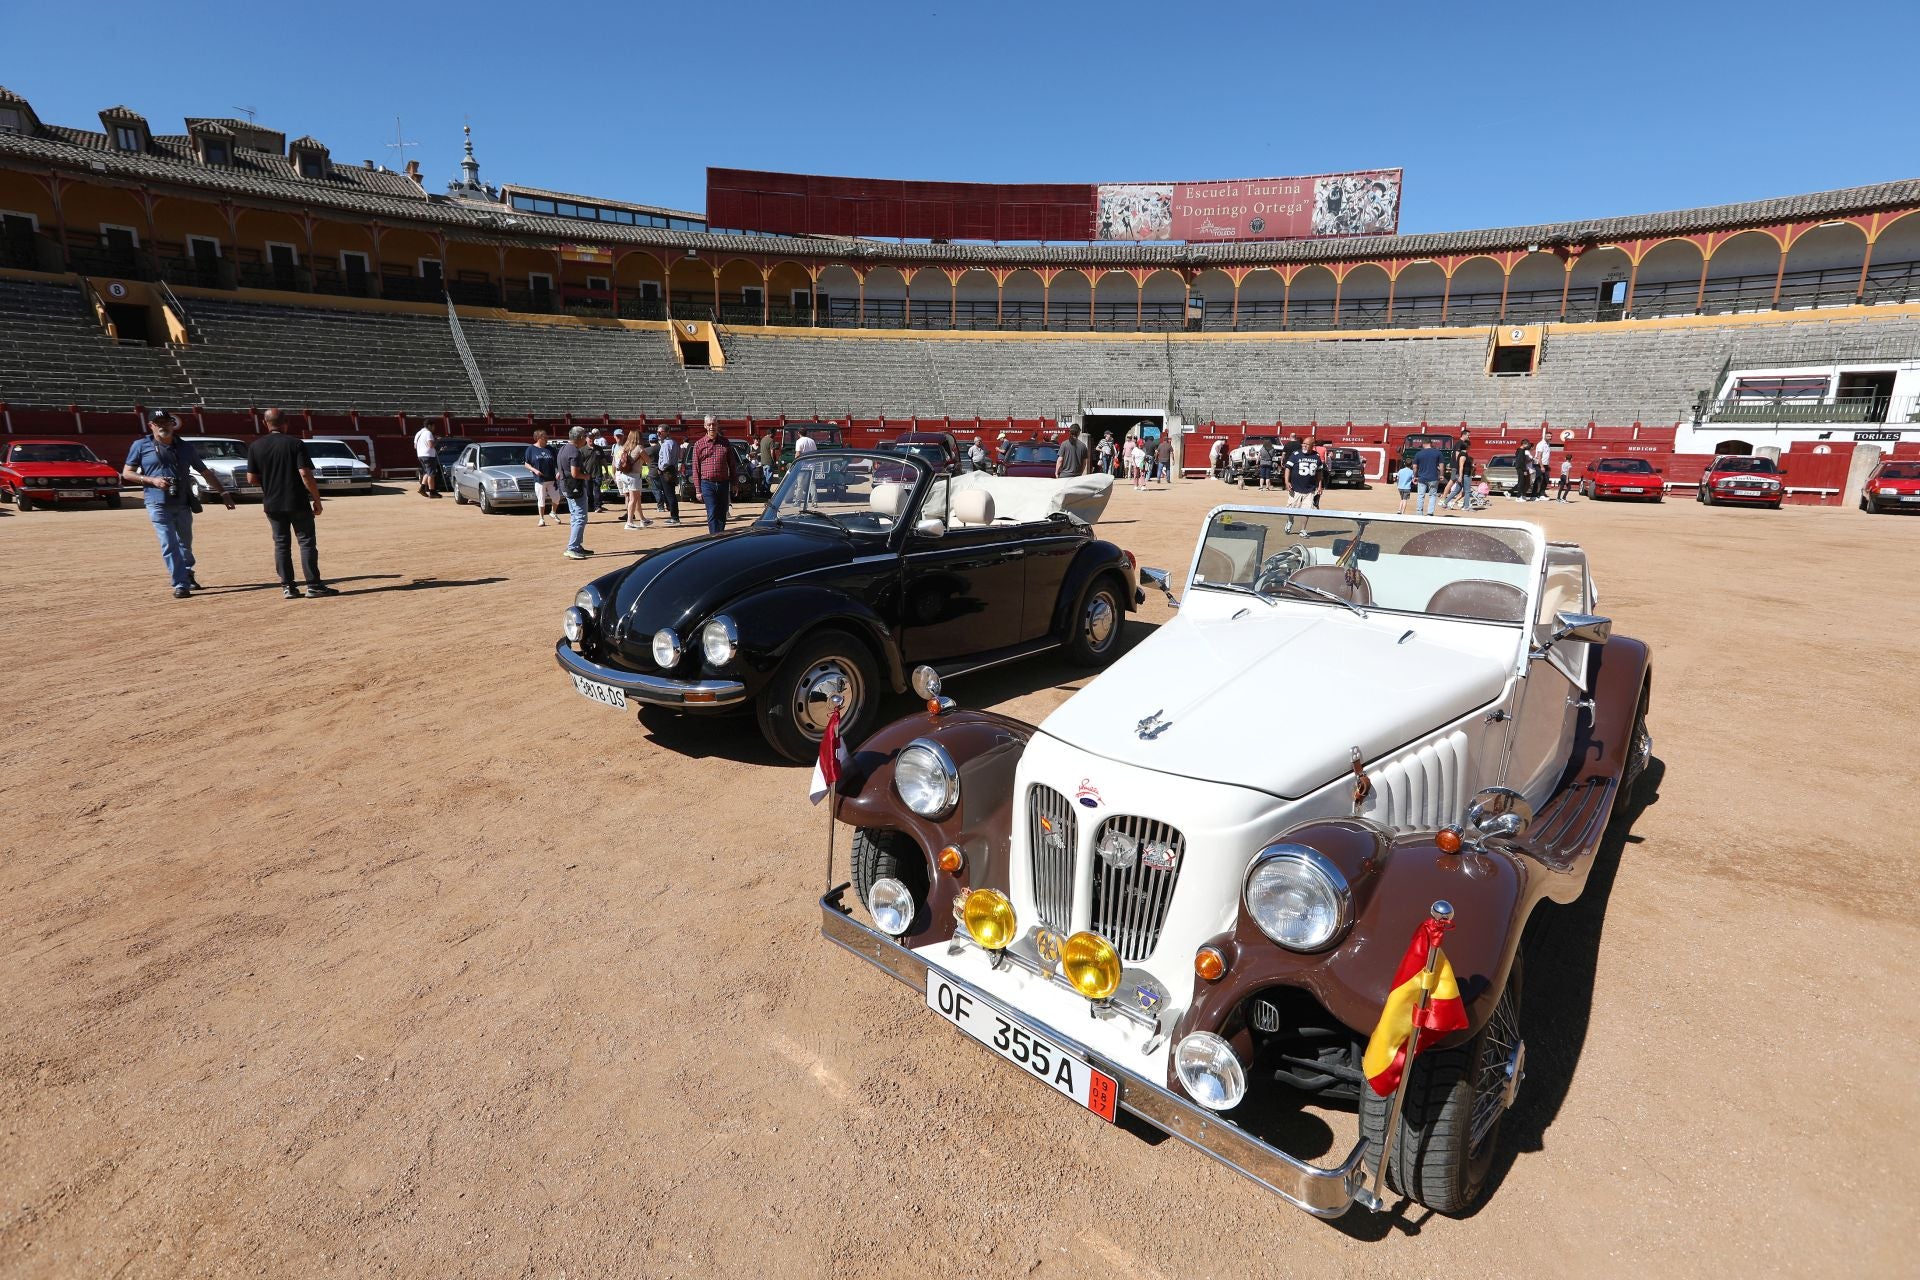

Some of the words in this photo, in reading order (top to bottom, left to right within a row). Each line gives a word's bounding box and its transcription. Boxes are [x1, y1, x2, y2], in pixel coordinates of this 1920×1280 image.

[1186, 185, 1239, 200] Escuela
[1245, 183, 1300, 197] Taurina
[1176, 203, 1247, 219] “Domingo
[1253, 200, 1309, 217] Ortega”
[114, 285, 121, 295] 8
[1855, 432, 1900, 440] TORILES
[938, 983, 973, 1021] OF
